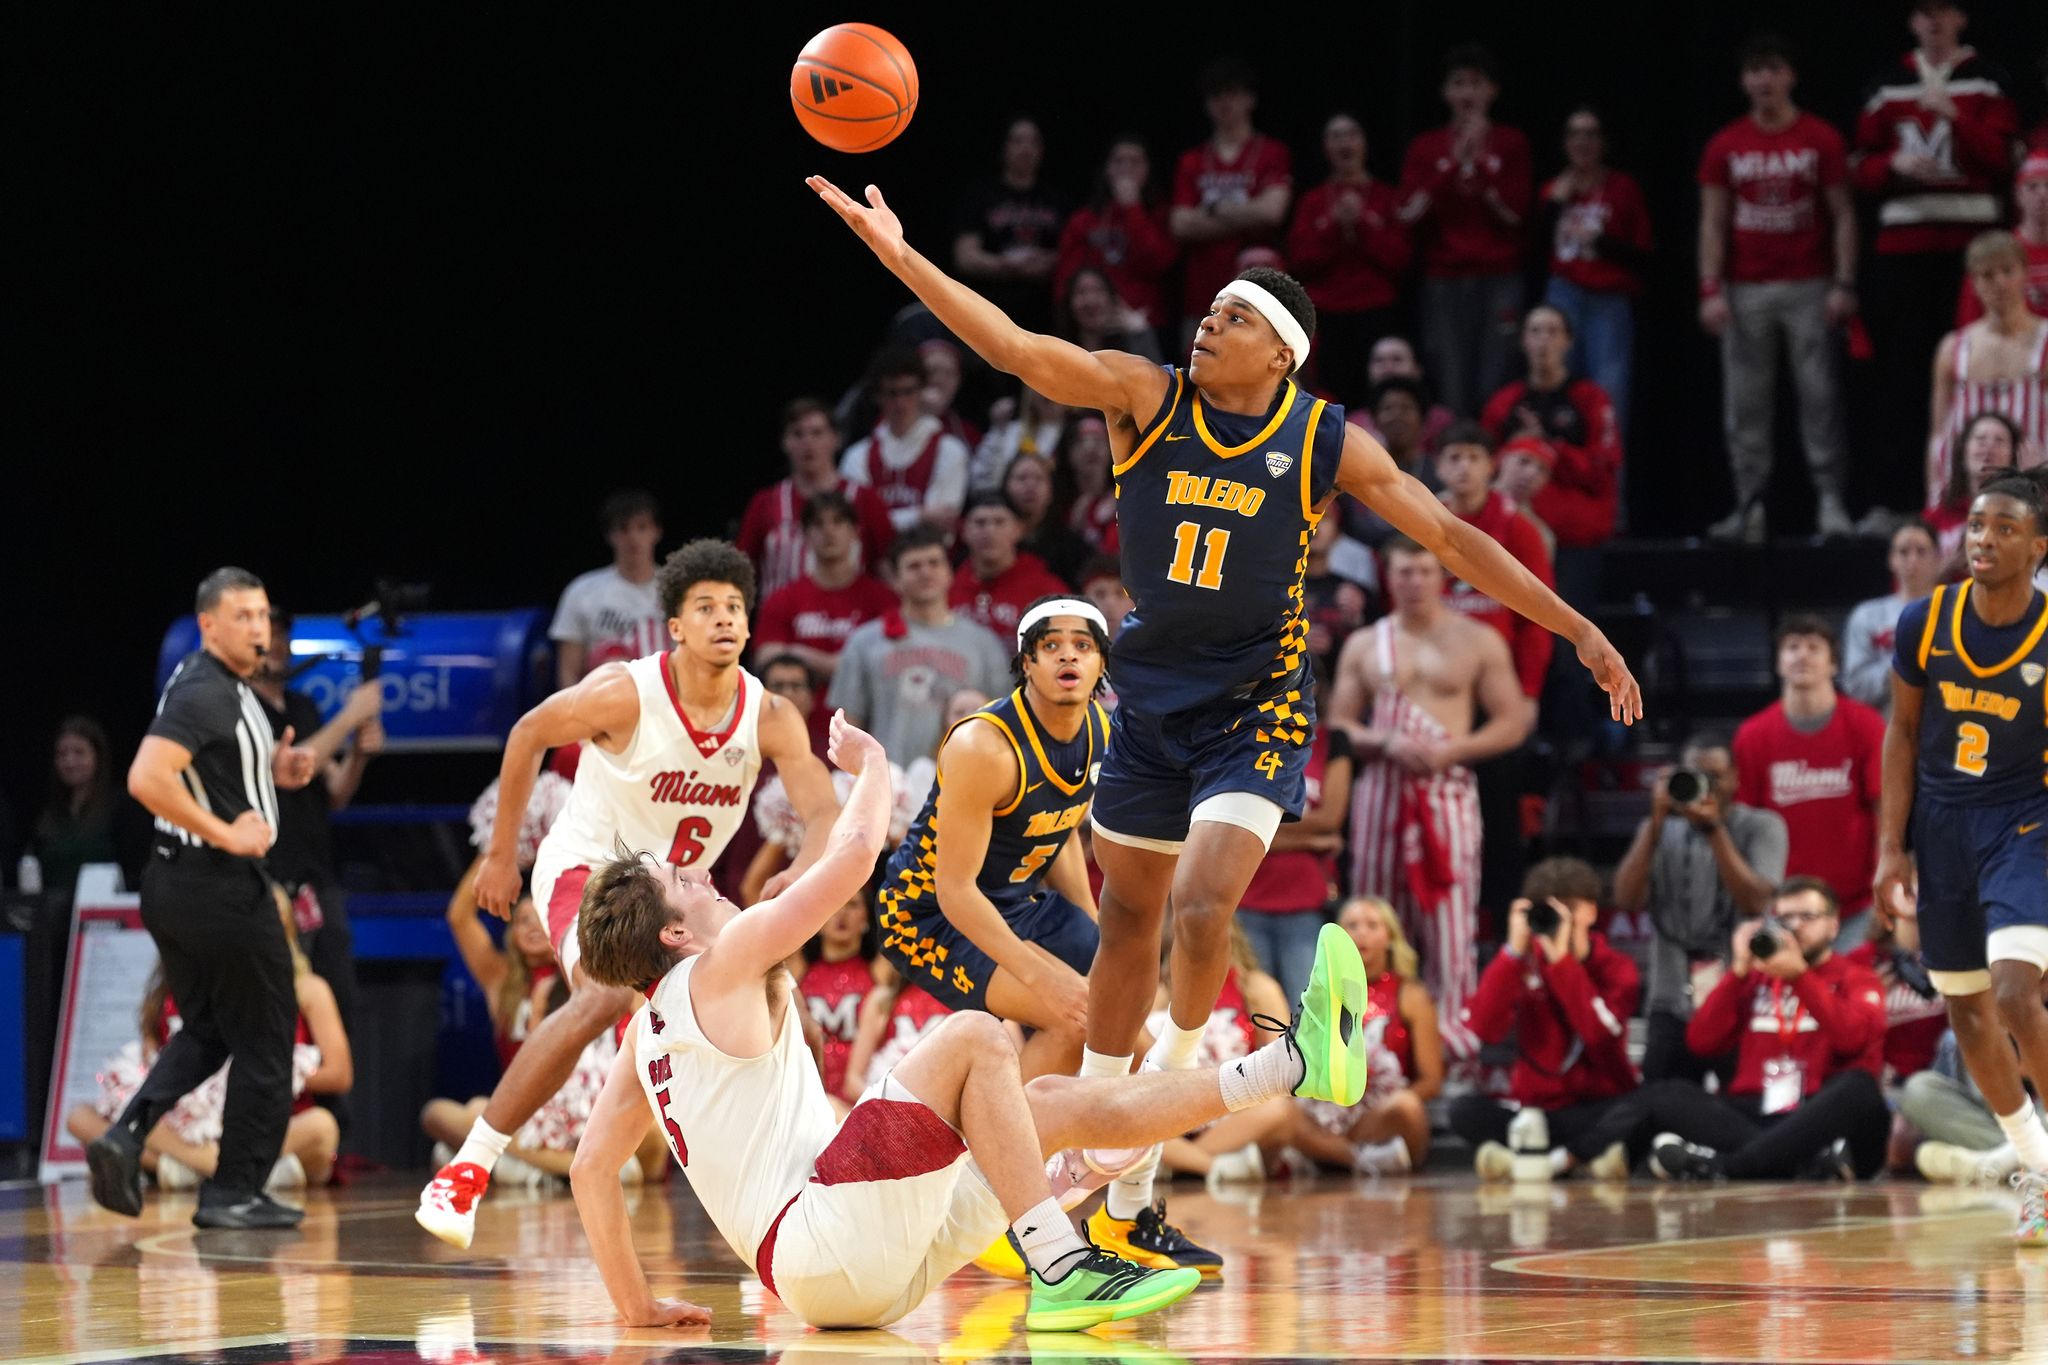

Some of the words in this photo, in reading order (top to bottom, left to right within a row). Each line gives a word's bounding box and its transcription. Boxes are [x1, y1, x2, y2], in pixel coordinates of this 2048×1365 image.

[1165, 470, 1266, 517] TOLEDO
[1167, 520, 1231, 591] 11
[1939, 680, 2021, 721] TOLEDO
[1954, 721, 1990, 777] 2
[1771, 758, 1853, 794] Miami
[667, 816, 712, 867] 6
[1008, 843, 1060, 883] 5
[807, 993, 862, 1041] M
[656, 1087, 689, 1168] 5
